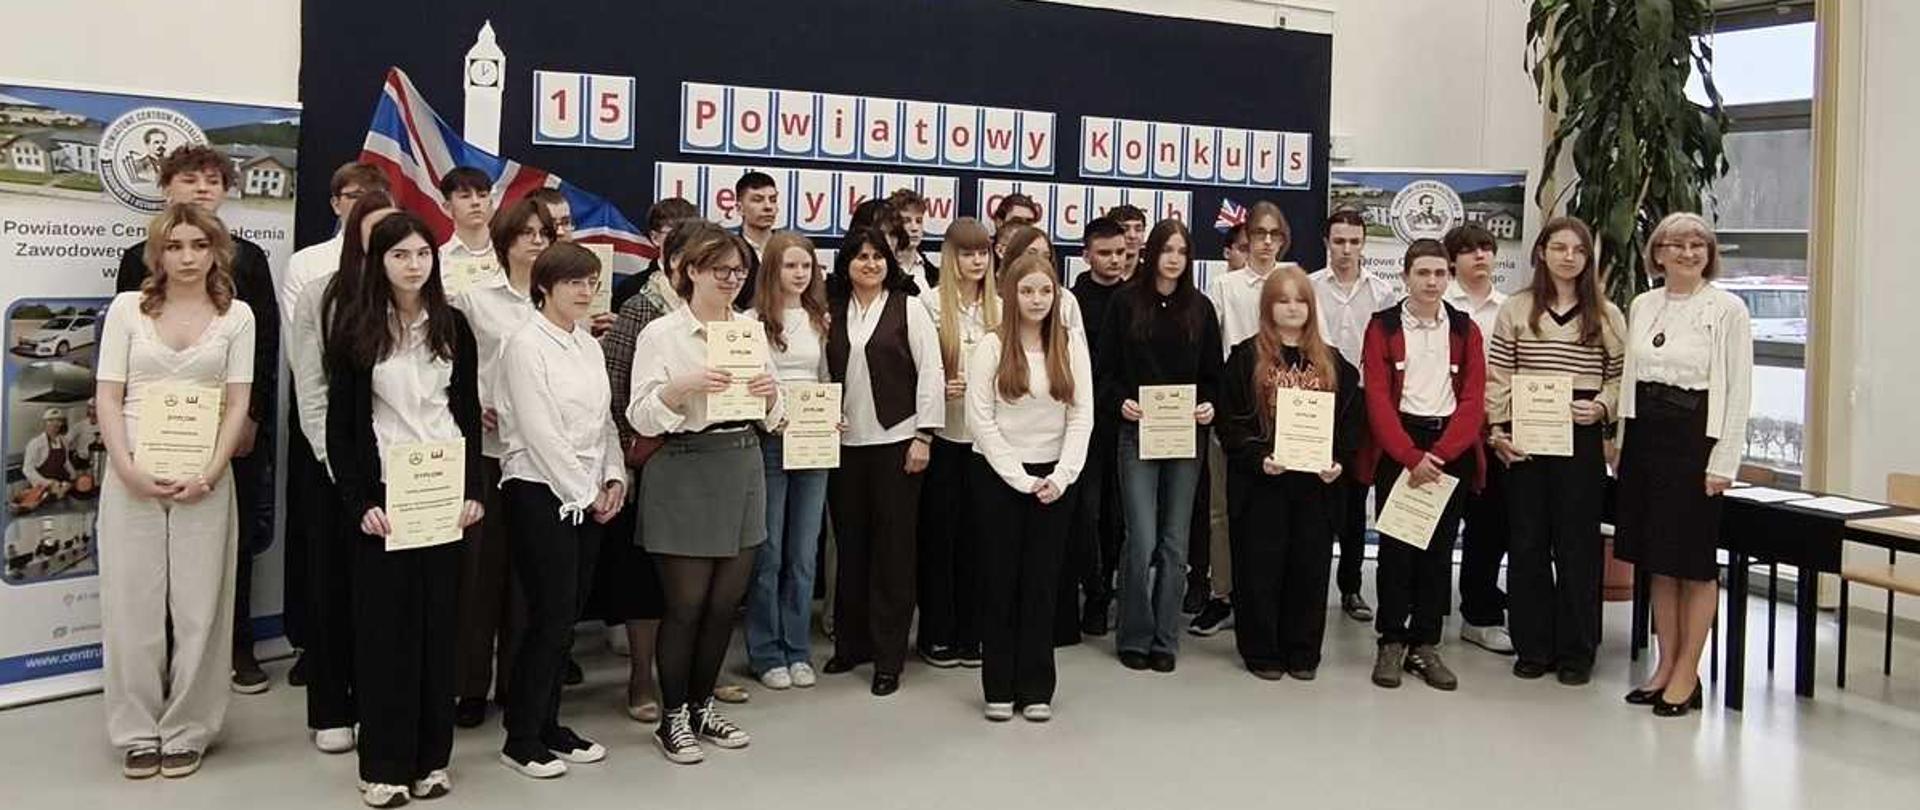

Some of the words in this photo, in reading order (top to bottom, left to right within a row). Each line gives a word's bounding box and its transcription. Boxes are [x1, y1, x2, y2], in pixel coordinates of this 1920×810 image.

[550, 88, 621, 124] 15
[696, 100, 1047, 161] Powiatowy
[1091, 130, 1303, 171] Konkurs
[3, 220, 107, 237] Powiatowe
[15, 242, 125, 259] Zawodoweg
